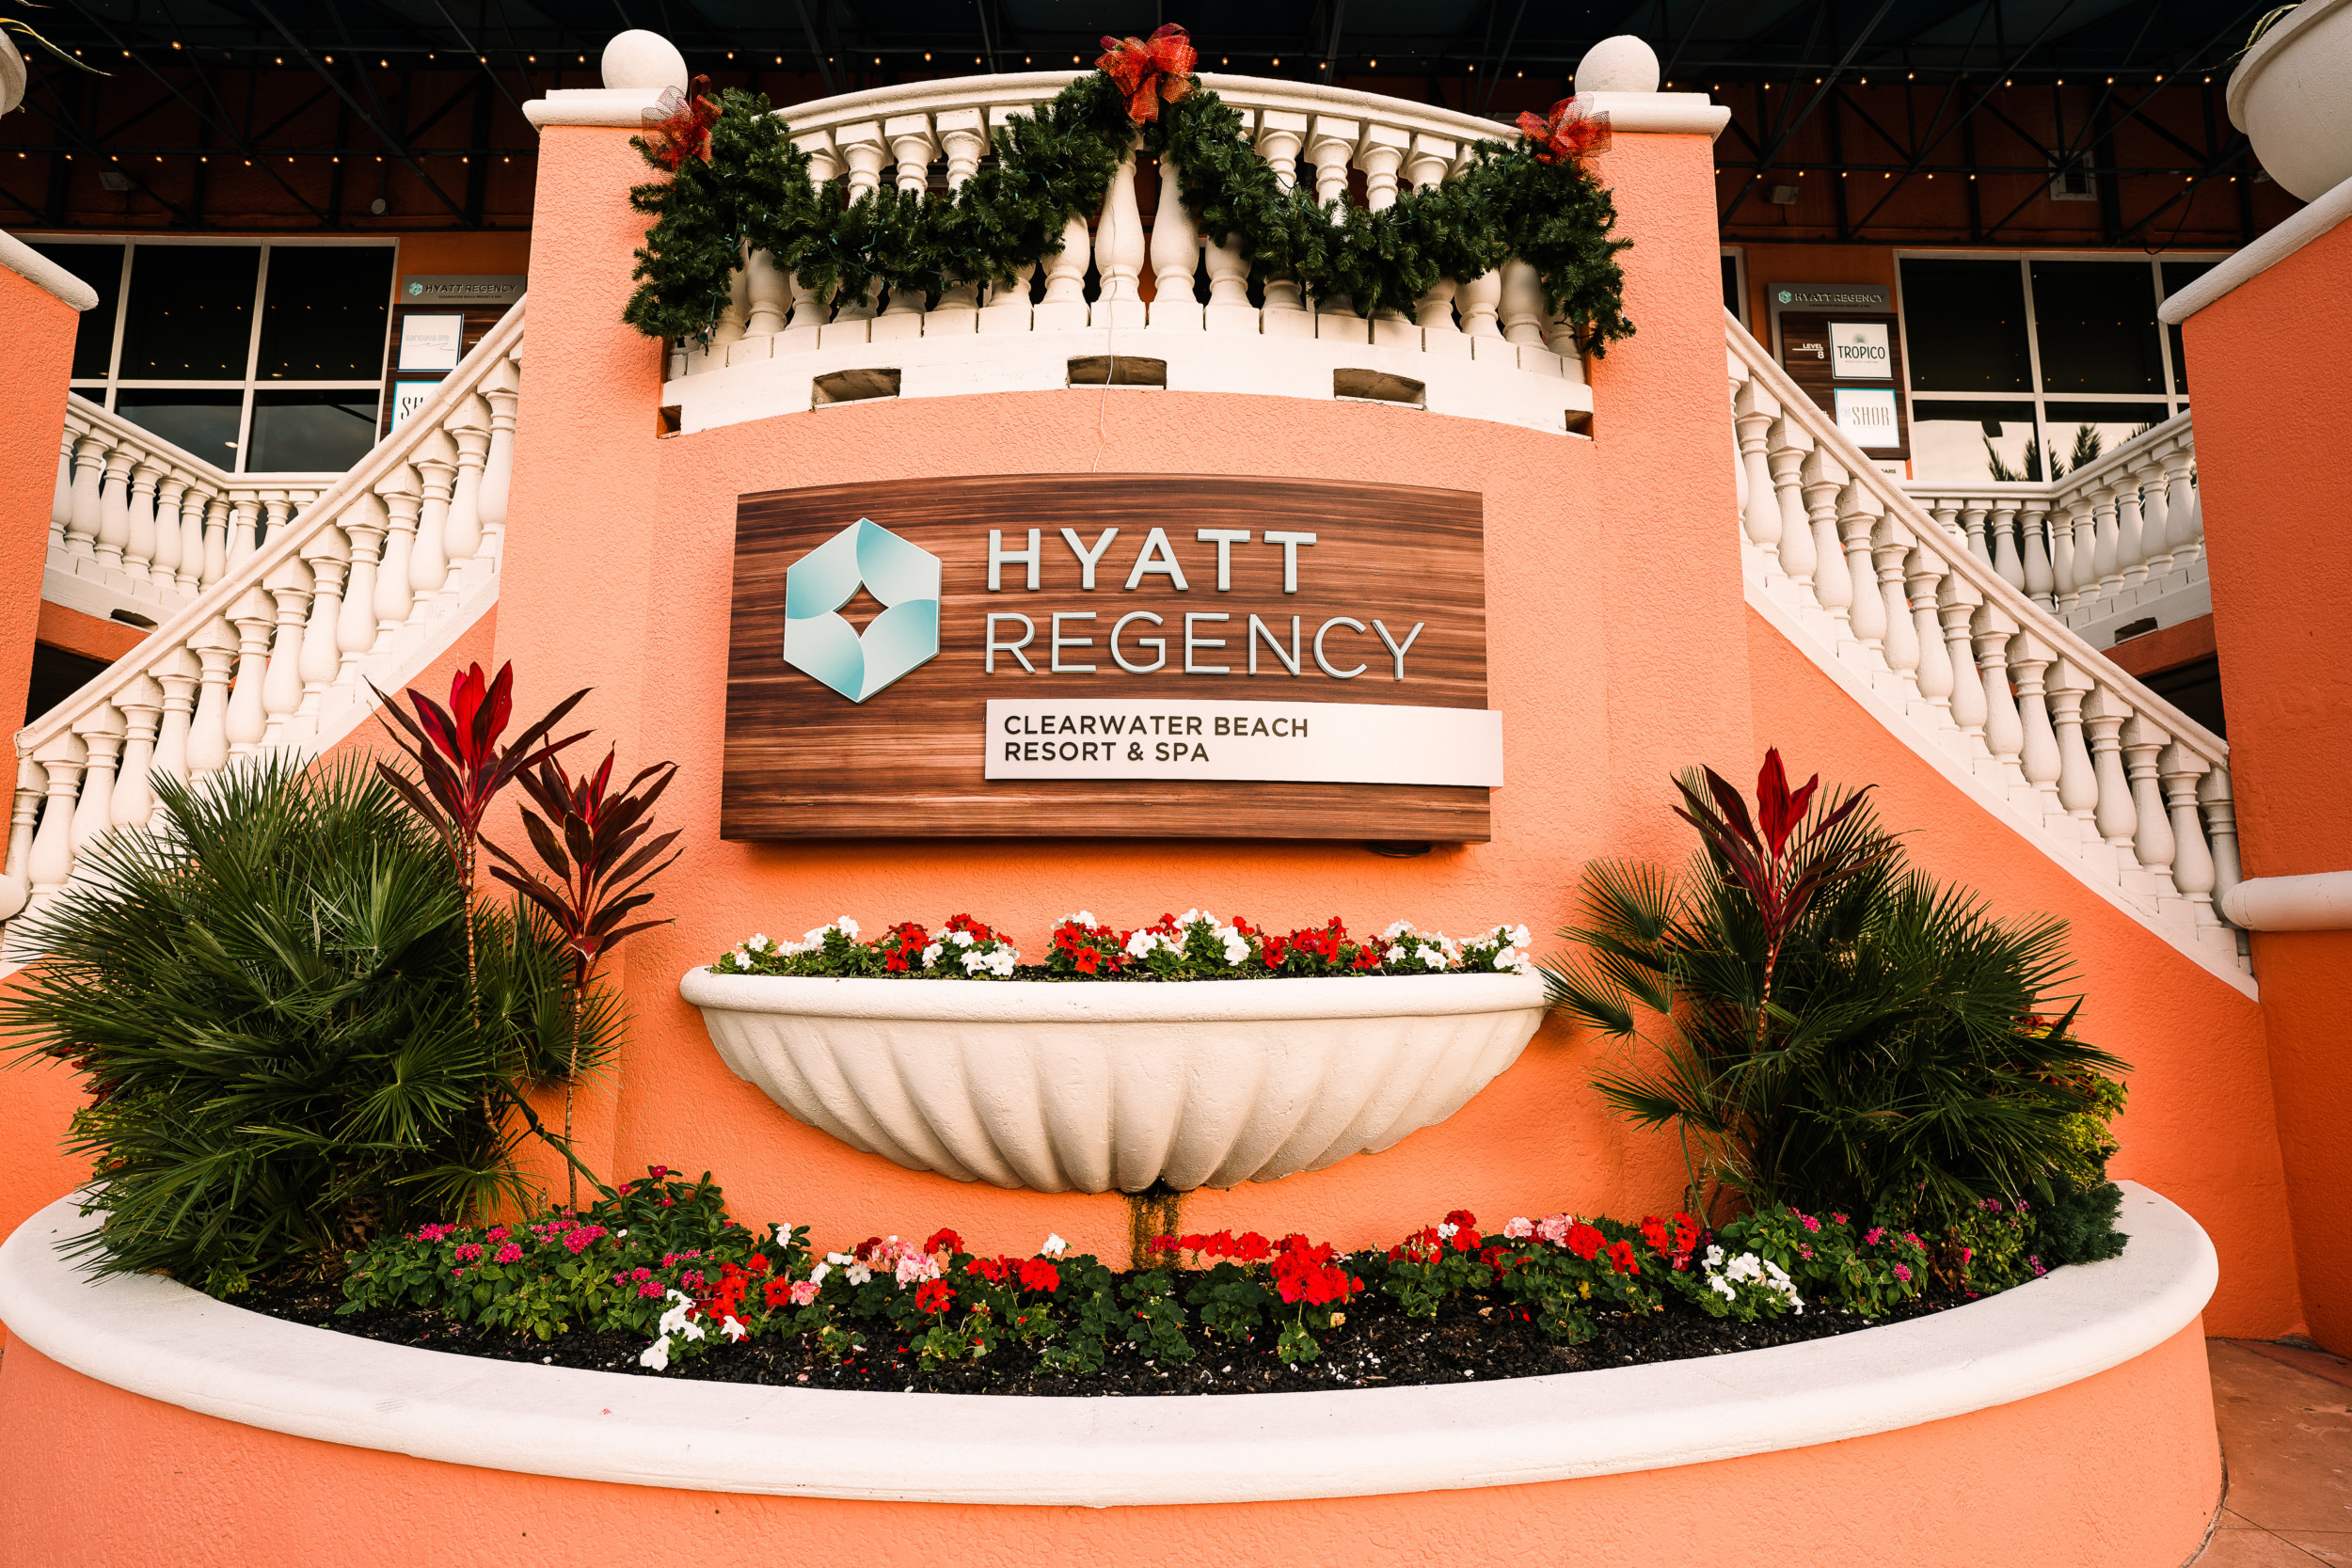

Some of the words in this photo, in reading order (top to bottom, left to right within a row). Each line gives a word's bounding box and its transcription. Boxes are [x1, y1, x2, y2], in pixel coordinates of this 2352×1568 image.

[425, 284, 463, 293] HYATT
[465, 284, 516, 293] REGENCY
[1795, 293, 1832, 302] HYATT
[1834, 293, 1883, 303] REGENCY
[1817, 351, 1825, 359] 8
[1836, 345, 1885, 359] TROPICO
[1851, 405, 1890, 426] SHOR
[987, 527, 1317, 594] HYATT
[985, 610, 1425, 681] REGENCY
[1004, 715, 1202, 736] CLEARWATER
[1214, 717, 1309, 737] BEACH
[1004, 741, 1117, 762] RESORT
[1127, 742, 1144, 762] &
[1154, 743, 1210, 763] SPA
